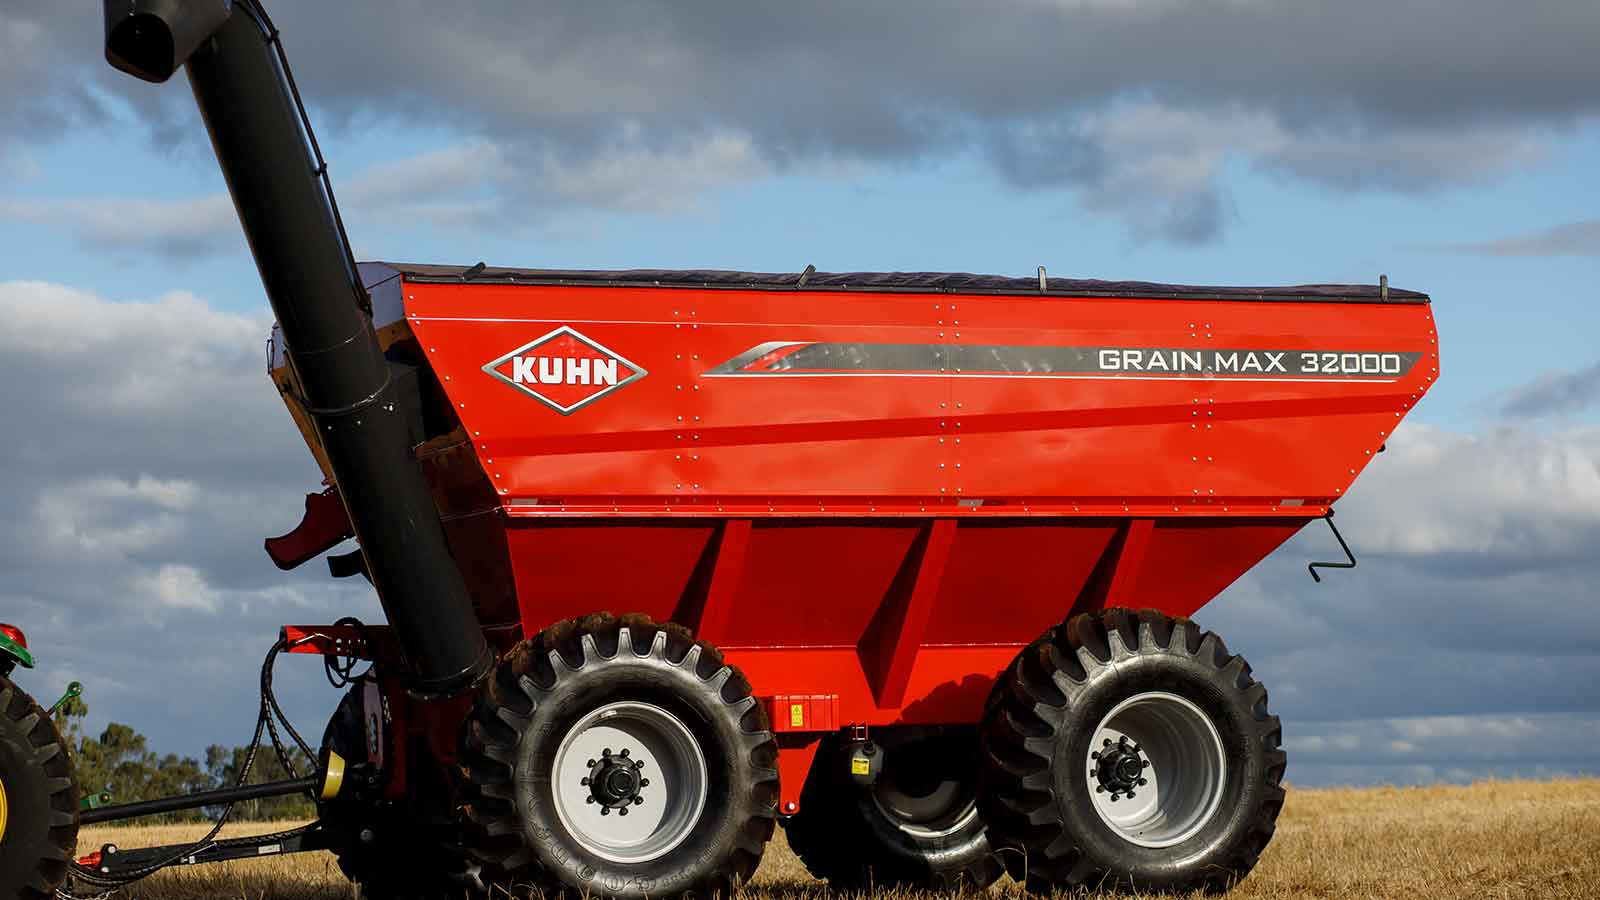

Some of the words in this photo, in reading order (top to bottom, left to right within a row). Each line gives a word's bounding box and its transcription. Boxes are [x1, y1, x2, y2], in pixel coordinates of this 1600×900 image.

[512, 356, 618, 386] KUHN
[1098, 349, 1202, 371] GRAIN
[1215, 351, 1287, 373] MAX
[1300, 352, 1401, 375] 32000
